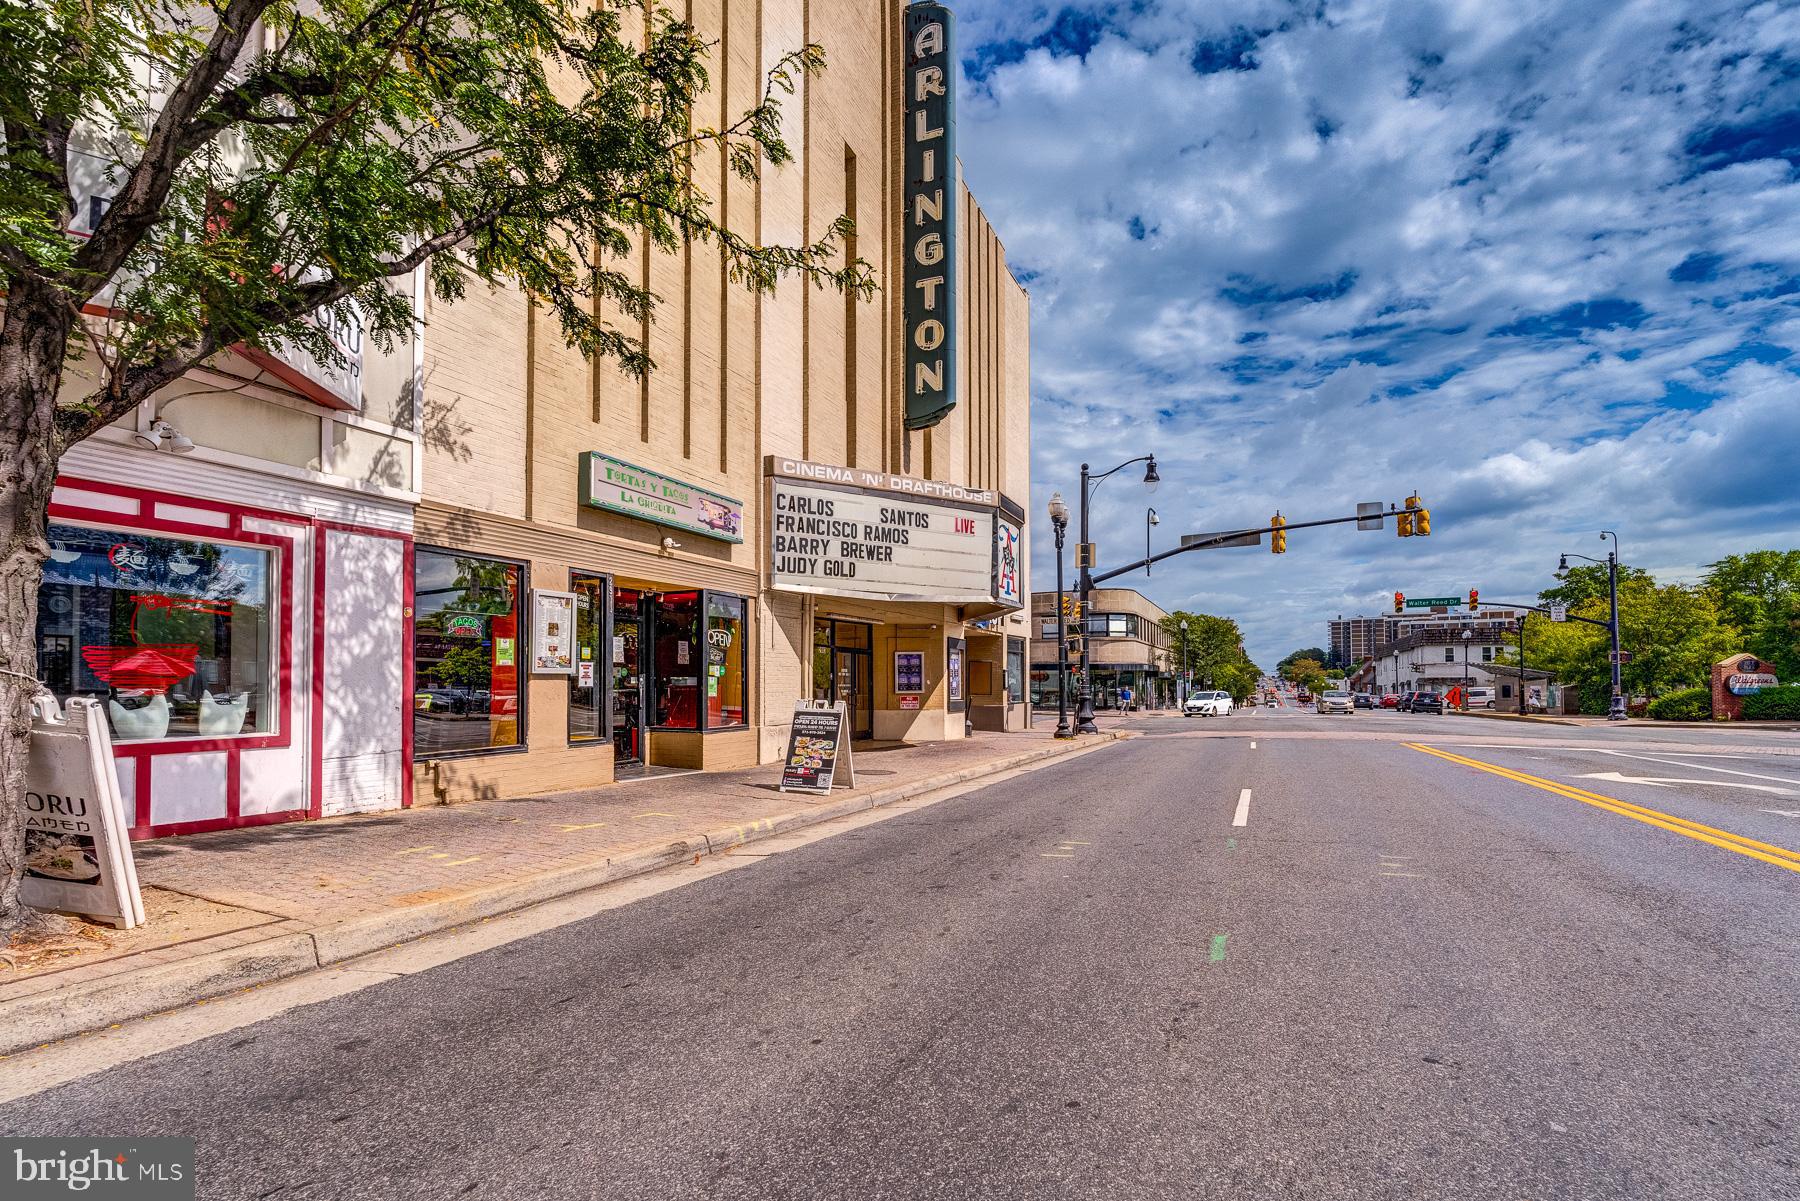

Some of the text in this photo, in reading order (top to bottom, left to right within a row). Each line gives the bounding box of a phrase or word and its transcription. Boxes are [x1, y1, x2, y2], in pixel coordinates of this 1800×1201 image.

[914, 21, 946, 395] ARLINGTON
[605, 466, 689, 503] TORTAS Y TACOS
[782, 461, 854, 483] CINEMA
[890, 477, 992, 503] DRAFTHOUSE
[620, 490, 634, 503] LA
[776, 493, 834, 516] CARLOS
[776, 514, 909, 545] FRANCISCO RAMOS
[880, 508, 975, 535] SANTOS LIVE
[776, 535, 893, 562] BARRY BREWER
[776, 556, 856, 578] JUDY GOLD
[454, 617, 478, 628] TACOS
[707, 630, 731, 648] OPEN
[26, 792, 87, 817] ORU
[27, 816, 90, 833] AMEN
